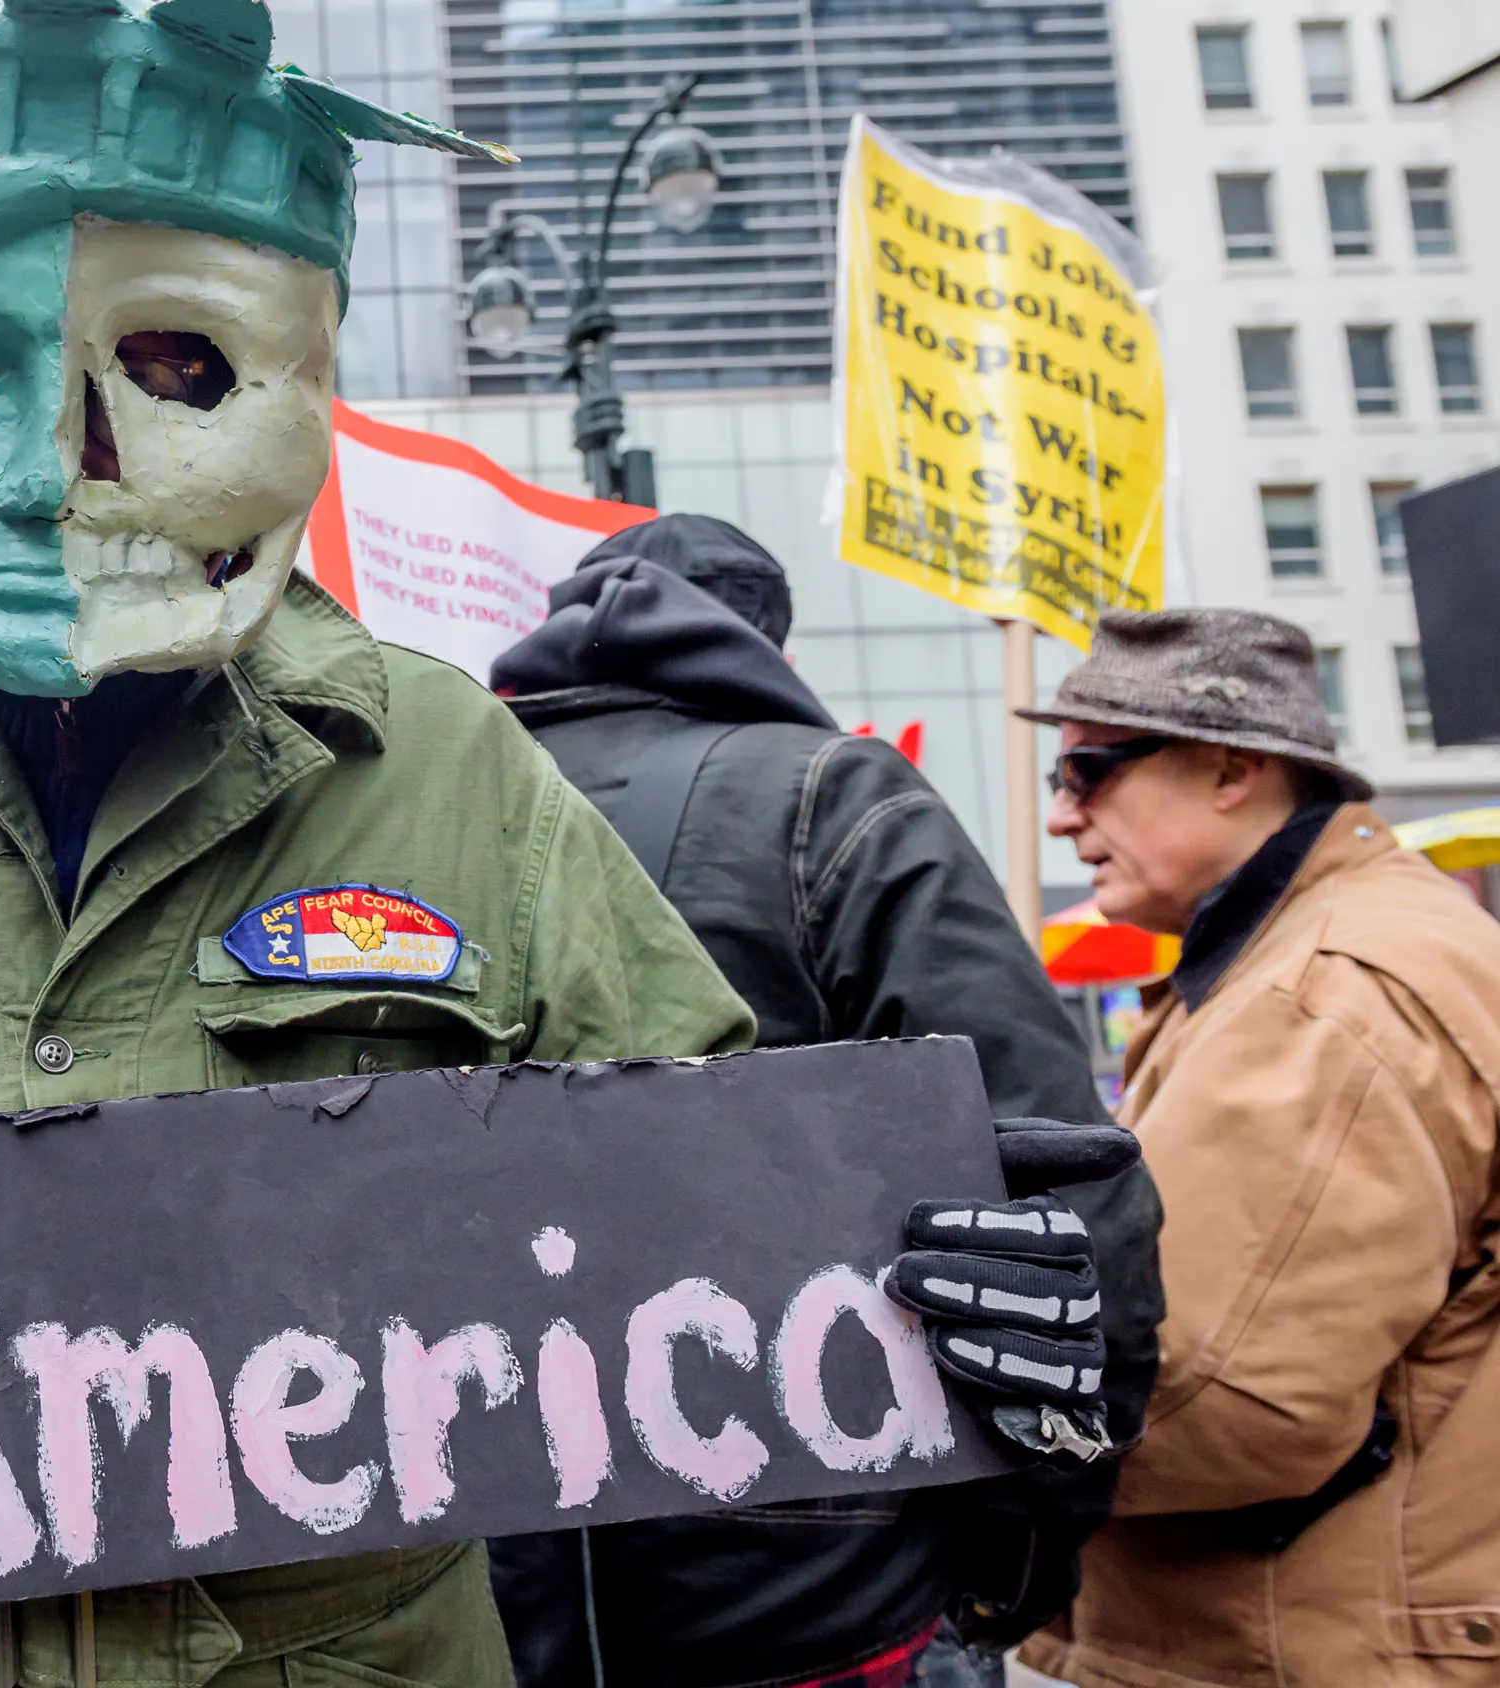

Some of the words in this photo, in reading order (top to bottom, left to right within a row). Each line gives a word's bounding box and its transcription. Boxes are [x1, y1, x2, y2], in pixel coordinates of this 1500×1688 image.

[870, 175, 1010, 256] Fund
[1028, 242, 1140, 317] Jobs
[877, 239, 1085, 340] Schools
[1102, 321, 1139, 364] &
[898, 375, 1006, 442] Not
[1027, 414, 1125, 492] War
[354, 507, 401, 541] THEY
[406, 530, 452, 555] LIED
[897, 437, 947, 491] in
[968, 467, 1125, 560] Syria!
[358, 538, 404, 571] THEY
[410, 561, 457, 587] LIED
[304, 893, 354, 912] FEAR
[361, 893, 438, 933] COUNCIL
[311, 956, 364, 970] NORTH
[370, 956, 442, 972] CAROLINA
